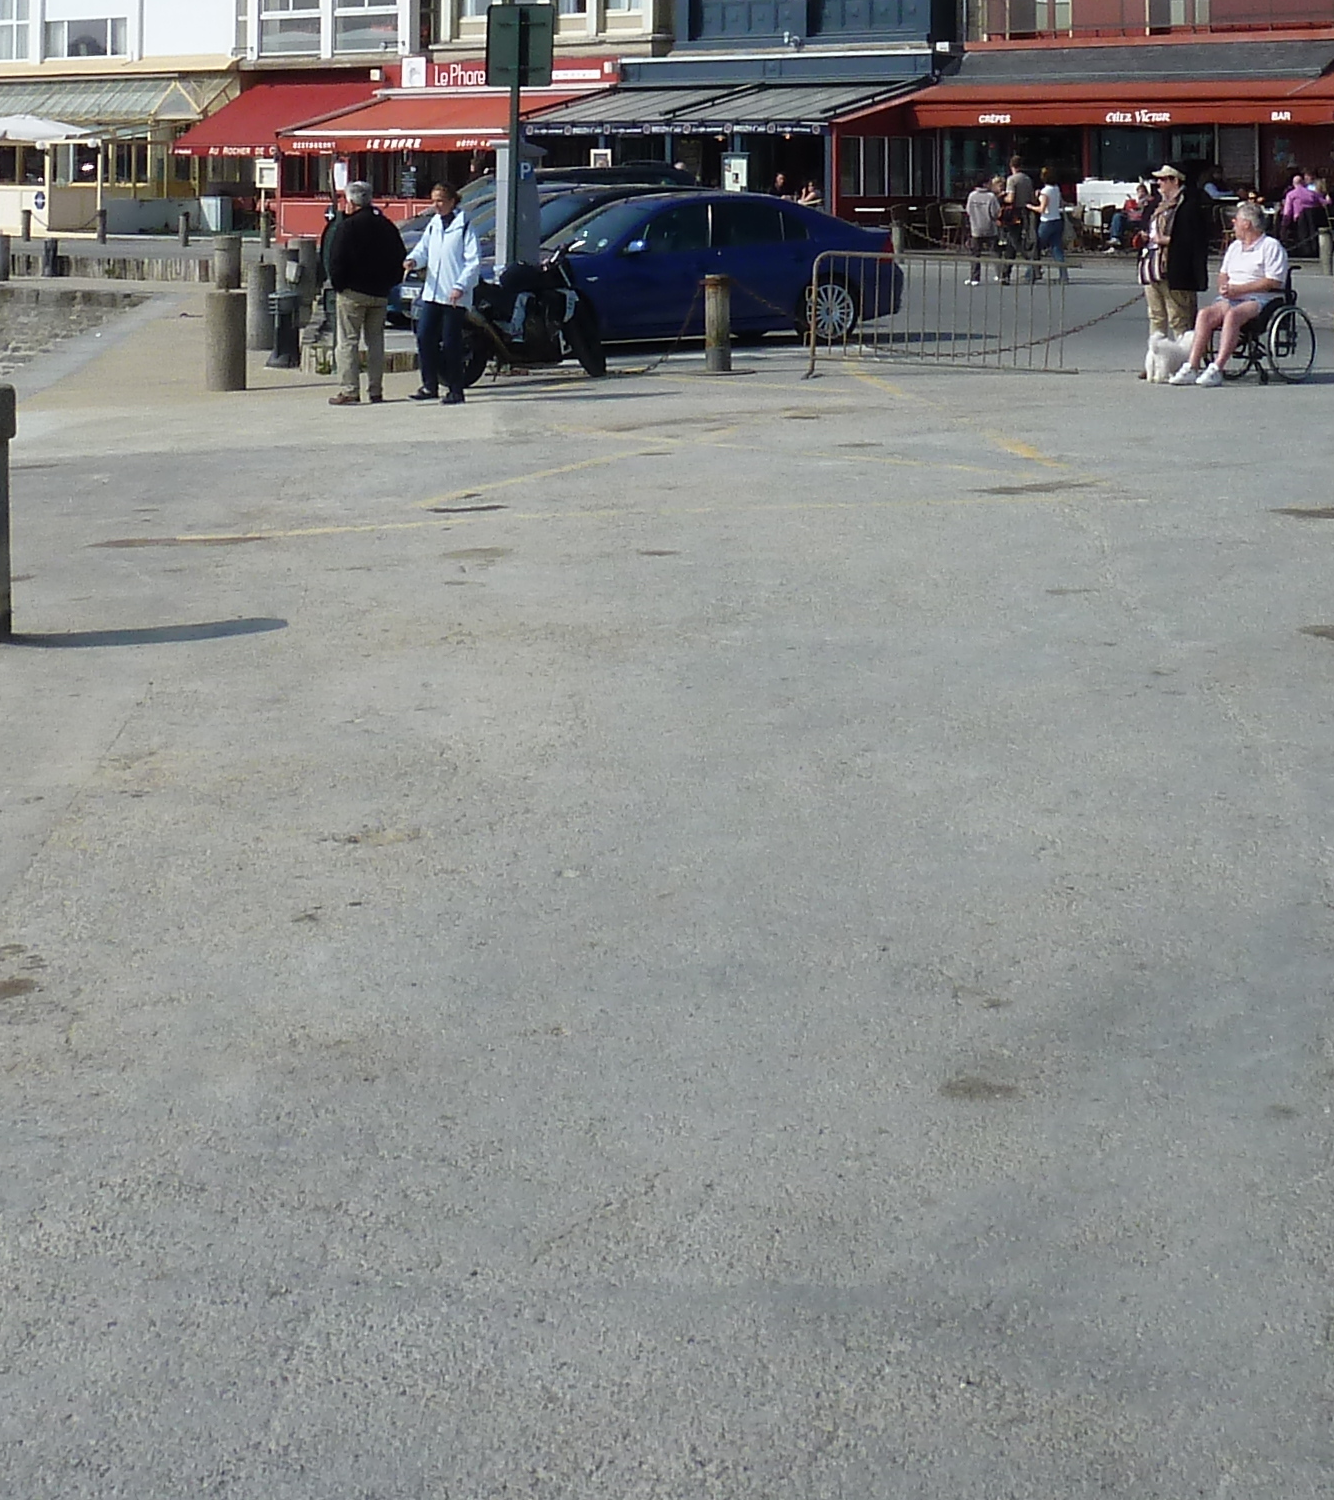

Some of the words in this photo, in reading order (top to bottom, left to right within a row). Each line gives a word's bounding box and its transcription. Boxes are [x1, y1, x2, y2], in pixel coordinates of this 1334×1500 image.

[434, 65, 449, 86] Le
[450, 63, 486, 86] Phare
[978, 113, 1011, 124] CRÊPES
[1271, 111, 1291, 121] BAR
[366, 139, 380, 149] LE
[383, 138, 422, 149] PHARE
[208, 146, 220, 155] AU
[222, 146, 251, 155] ROCHER
[255, 147, 265, 155] DE
[520, 161, 532, 180] P
